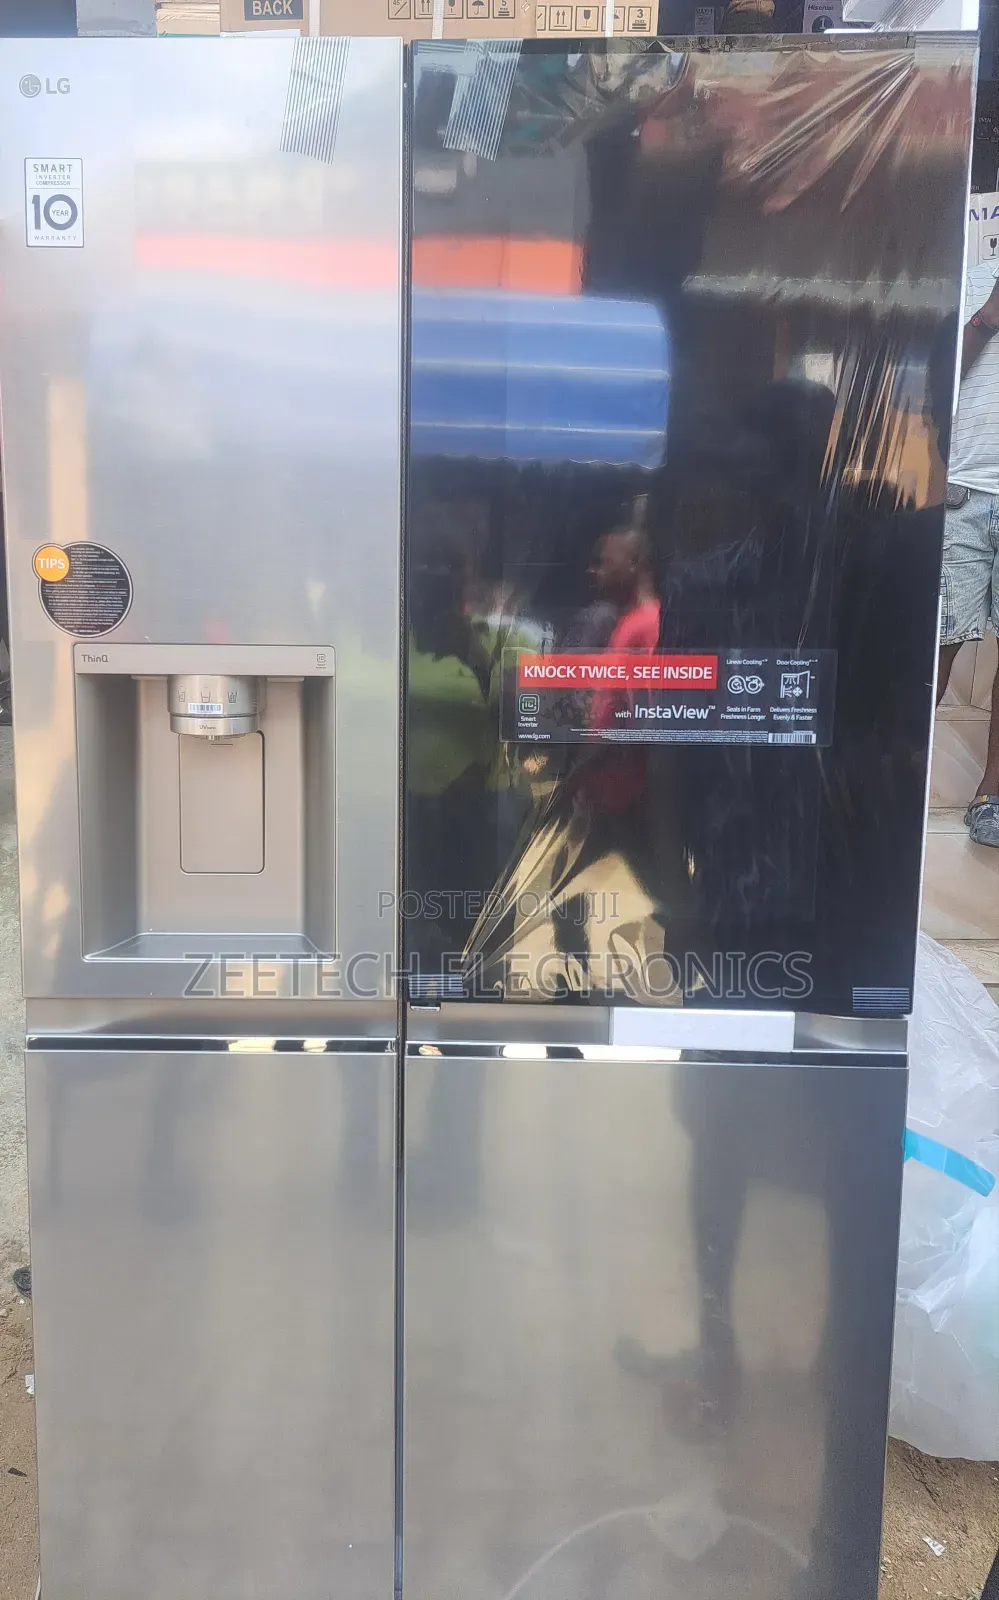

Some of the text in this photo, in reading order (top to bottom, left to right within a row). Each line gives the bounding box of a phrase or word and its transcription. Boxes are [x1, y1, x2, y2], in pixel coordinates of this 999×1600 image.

[252, 0, 293, 16] BACK
[636, 8, 644, 18] 3
[45, 77, 71, 95] LG
[33, 163, 73, 173] SMART
[31, 193, 78, 231] 10
[51, 209, 69, 217] YEAR
[38, 557, 66, 569] TIPS
[81, 653, 109, 664] ThinQ
[524, 665, 713, 681] KNOCK TWICE, SEE INSIDE
[615, 710, 632, 718] with
[747, 714, 766, 722] Longer
